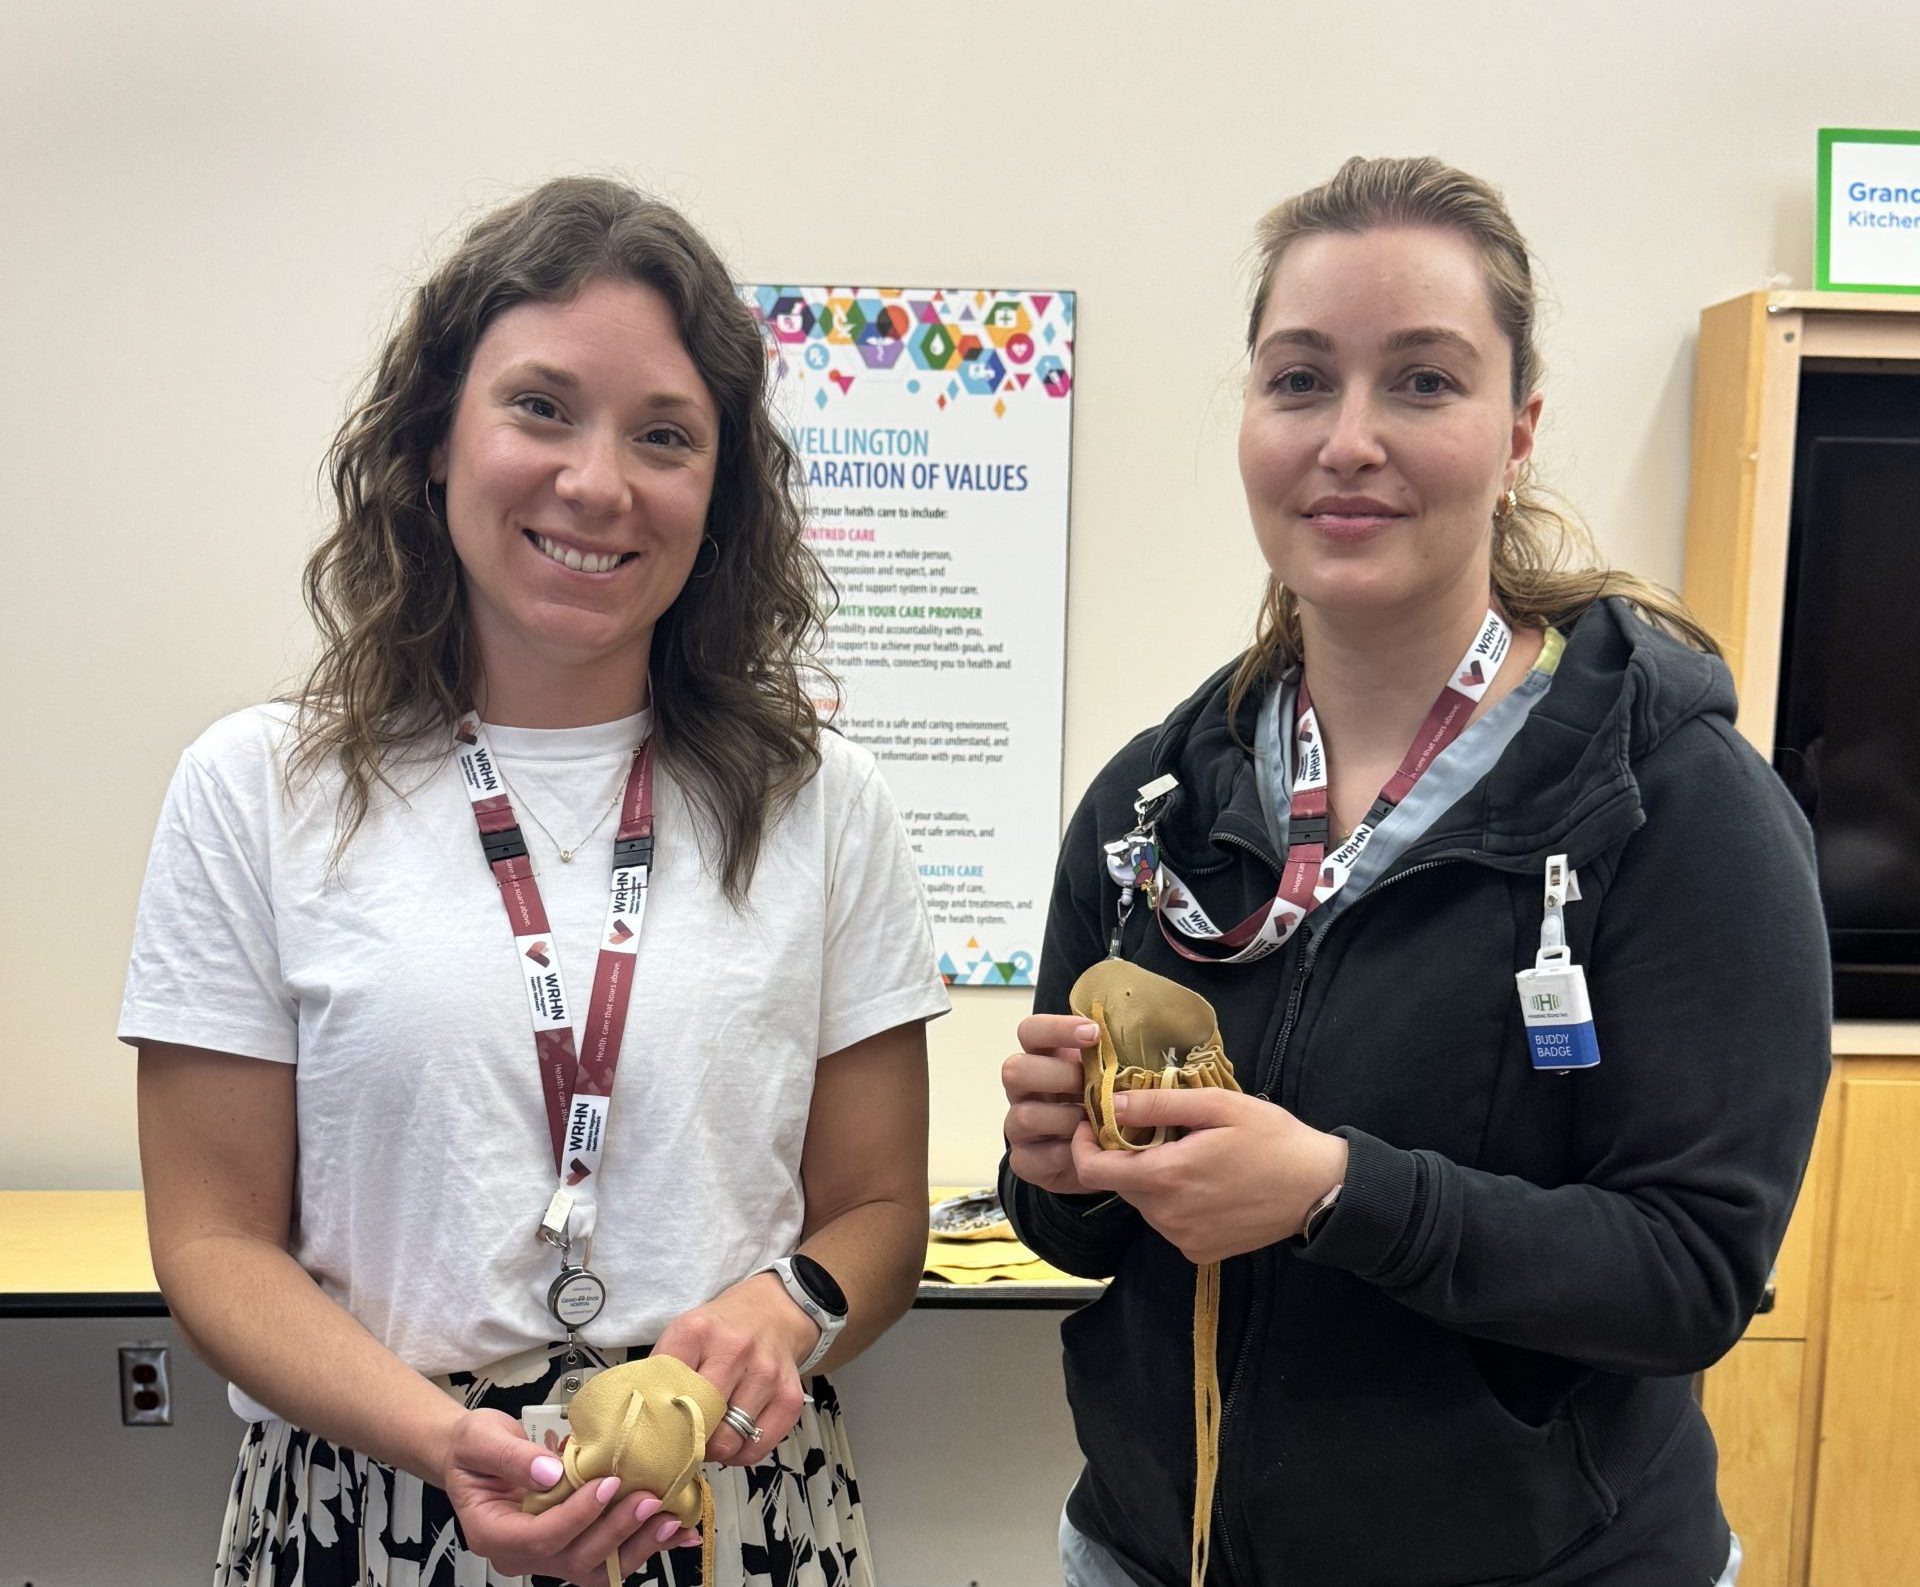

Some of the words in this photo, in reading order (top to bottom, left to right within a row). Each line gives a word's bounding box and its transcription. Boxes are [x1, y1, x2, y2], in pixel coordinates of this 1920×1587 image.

[803, 460, 905, 489] ARATION
[912, 462, 940, 490] OF
[946, 464, 1028, 491] VALUES
[821, 507, 842, 518] your
[844, 506, 874, 516] health
[877, 508, 896, 517] care
[899, 508, 909, 517] to
[848, 529, 875, 541] CARE
[855, 550, 871, 560] you
[895, 549, 920, 558] whole
[878, 565, 893, 574] and
[929, 566, 945, 576] and
[849, 583, 864, 592] and
[940, 586, 958, 596] your
[838, 605, 865, 617] WITH
[868, 606, 896, 617] YOUR
[899, 606, 926, 618] CARE
[928, 606, 983, 619] PROVIDER
[868, 624, 884, 634] and
[945, 626, 963, 635] with
[1475, 617, 1500, 655] WRHN
[914, 643, 931, 653] your
[933, 642, 958, 652] health
[988, 643, 1003, 652] and
[941, 660, 955, 670] you
[967, 659, 993, 669] health
[996, 660, 1011, 669] and
[911, 720, 927, 729] and
[895, 735, 911, 744] that
[913, 737, 928, 748] you
[930, 737, 942, 746] can
[994, 737, 1009, 746] and
[931, 752, 949, 762] with
[951, 754, 966, 764] you
[968, 753, 984, 762] and
[1309, 744, 1320, 782] WRHN
[474, 748, 499, 791] WRHN
[914, 812, 932, 822] your
[911, 827, 926, 836] and
[979, 828, 995, 837] and
[1333, 827, 1371, 864] WRHN
[957, 865, 984, 877] CARE
[612, 872, 629, 914] WRHN
[951, 899, 967, 908] and
[1017, 899, 1032, 909] and
[949, 914, 974, 924] health
[611, 961, 622, 983] above.
[545, 973, 566, 1020] WRHN
[608, 984, 617, 1002] soars
[605, 1003, 614, 1018] that
[602, 1019, 611, 1035] care
[1535, 1033, 1569, 1045] BUDDY
[595, 1037, 607, 1062] Health
[1537, 1046, 1573, 1058] BADGE
[554, 1063, 566, 1090] Health
[558, 1091, 567, 1108] care
[569, 1103, 590, 1151] WRHN
